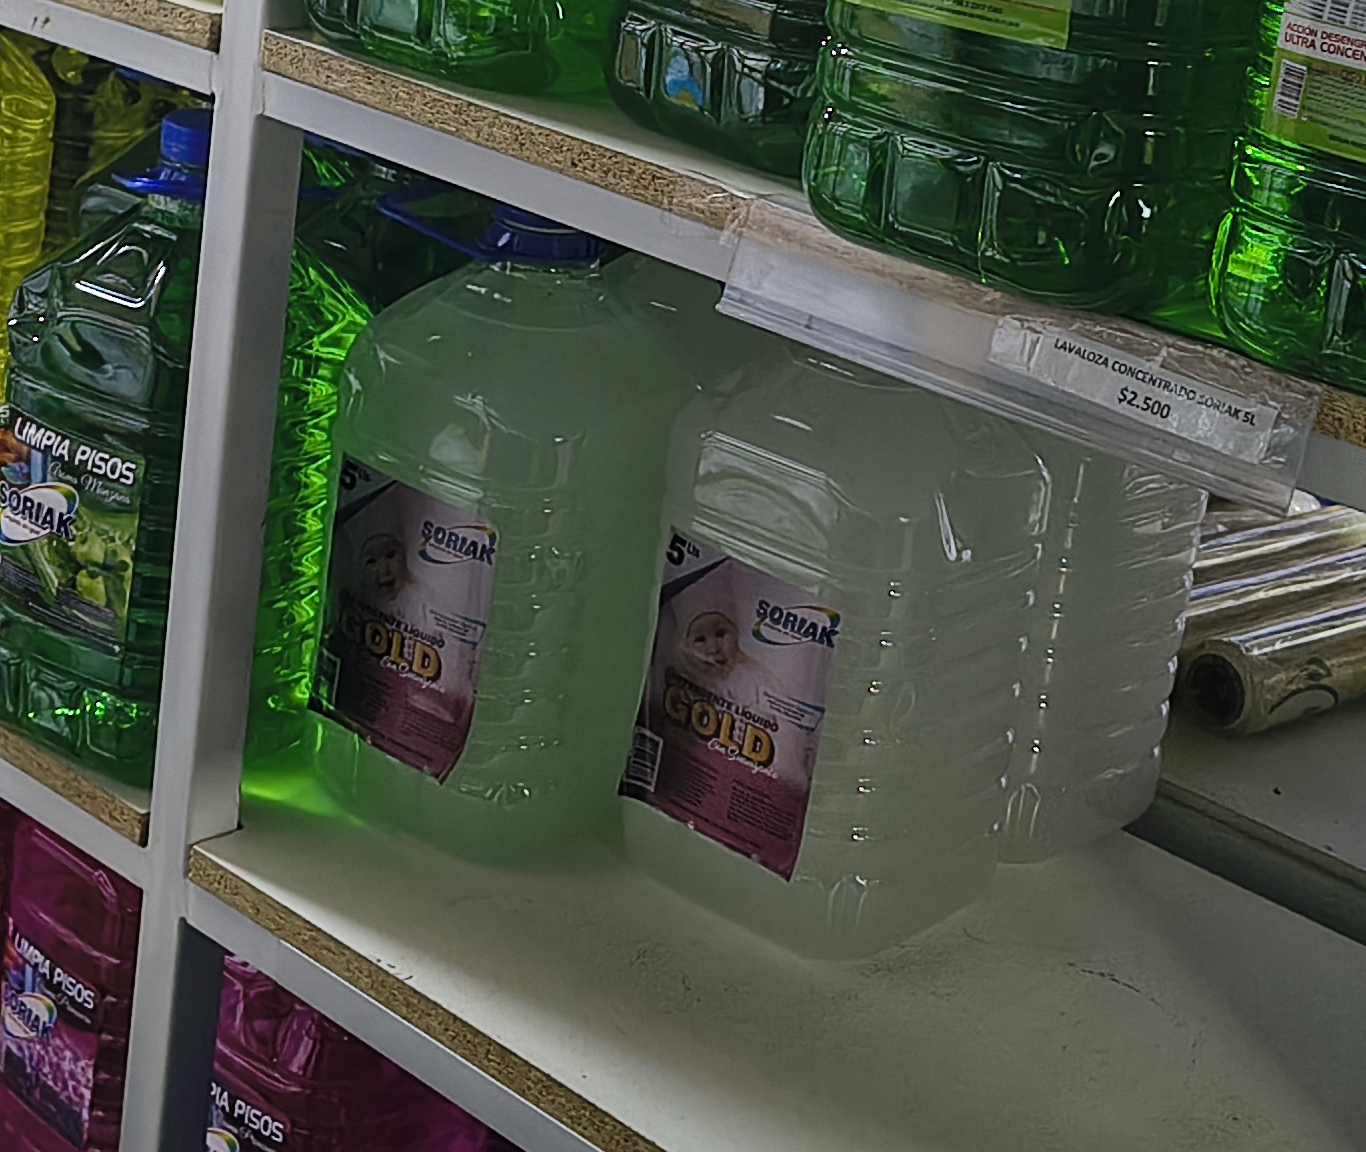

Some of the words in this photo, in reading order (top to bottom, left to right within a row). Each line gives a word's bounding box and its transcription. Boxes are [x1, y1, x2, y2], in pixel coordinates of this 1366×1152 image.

[1285, 32, 1316, 50] ULTRA
[1055, 338, 1109, 368] LAVALOZA
[1112, 360, 1197, 400] CONCENTRADO
[1242, 410, 1256, 426] 5L
[1117, 386, 1171, 419] $2.500
[0, 406, 10, 418] 5
[14, 417, 70, 461] LIMPIA
[75, 445, 136, 485] PISOS
[340, 460, 357, 490] 5
[421, 520, 496, 565] SORIAK
[665, 534, 687, 566] 5
[756, 599, 839, 648] SORIAK
[664, 686, 776, 769] GOLD
[15, 933, 50, 979] LIMPIA
[54, 967, 95, 1010] PISOS
[235, 1098, 284, 1143] PISOS
